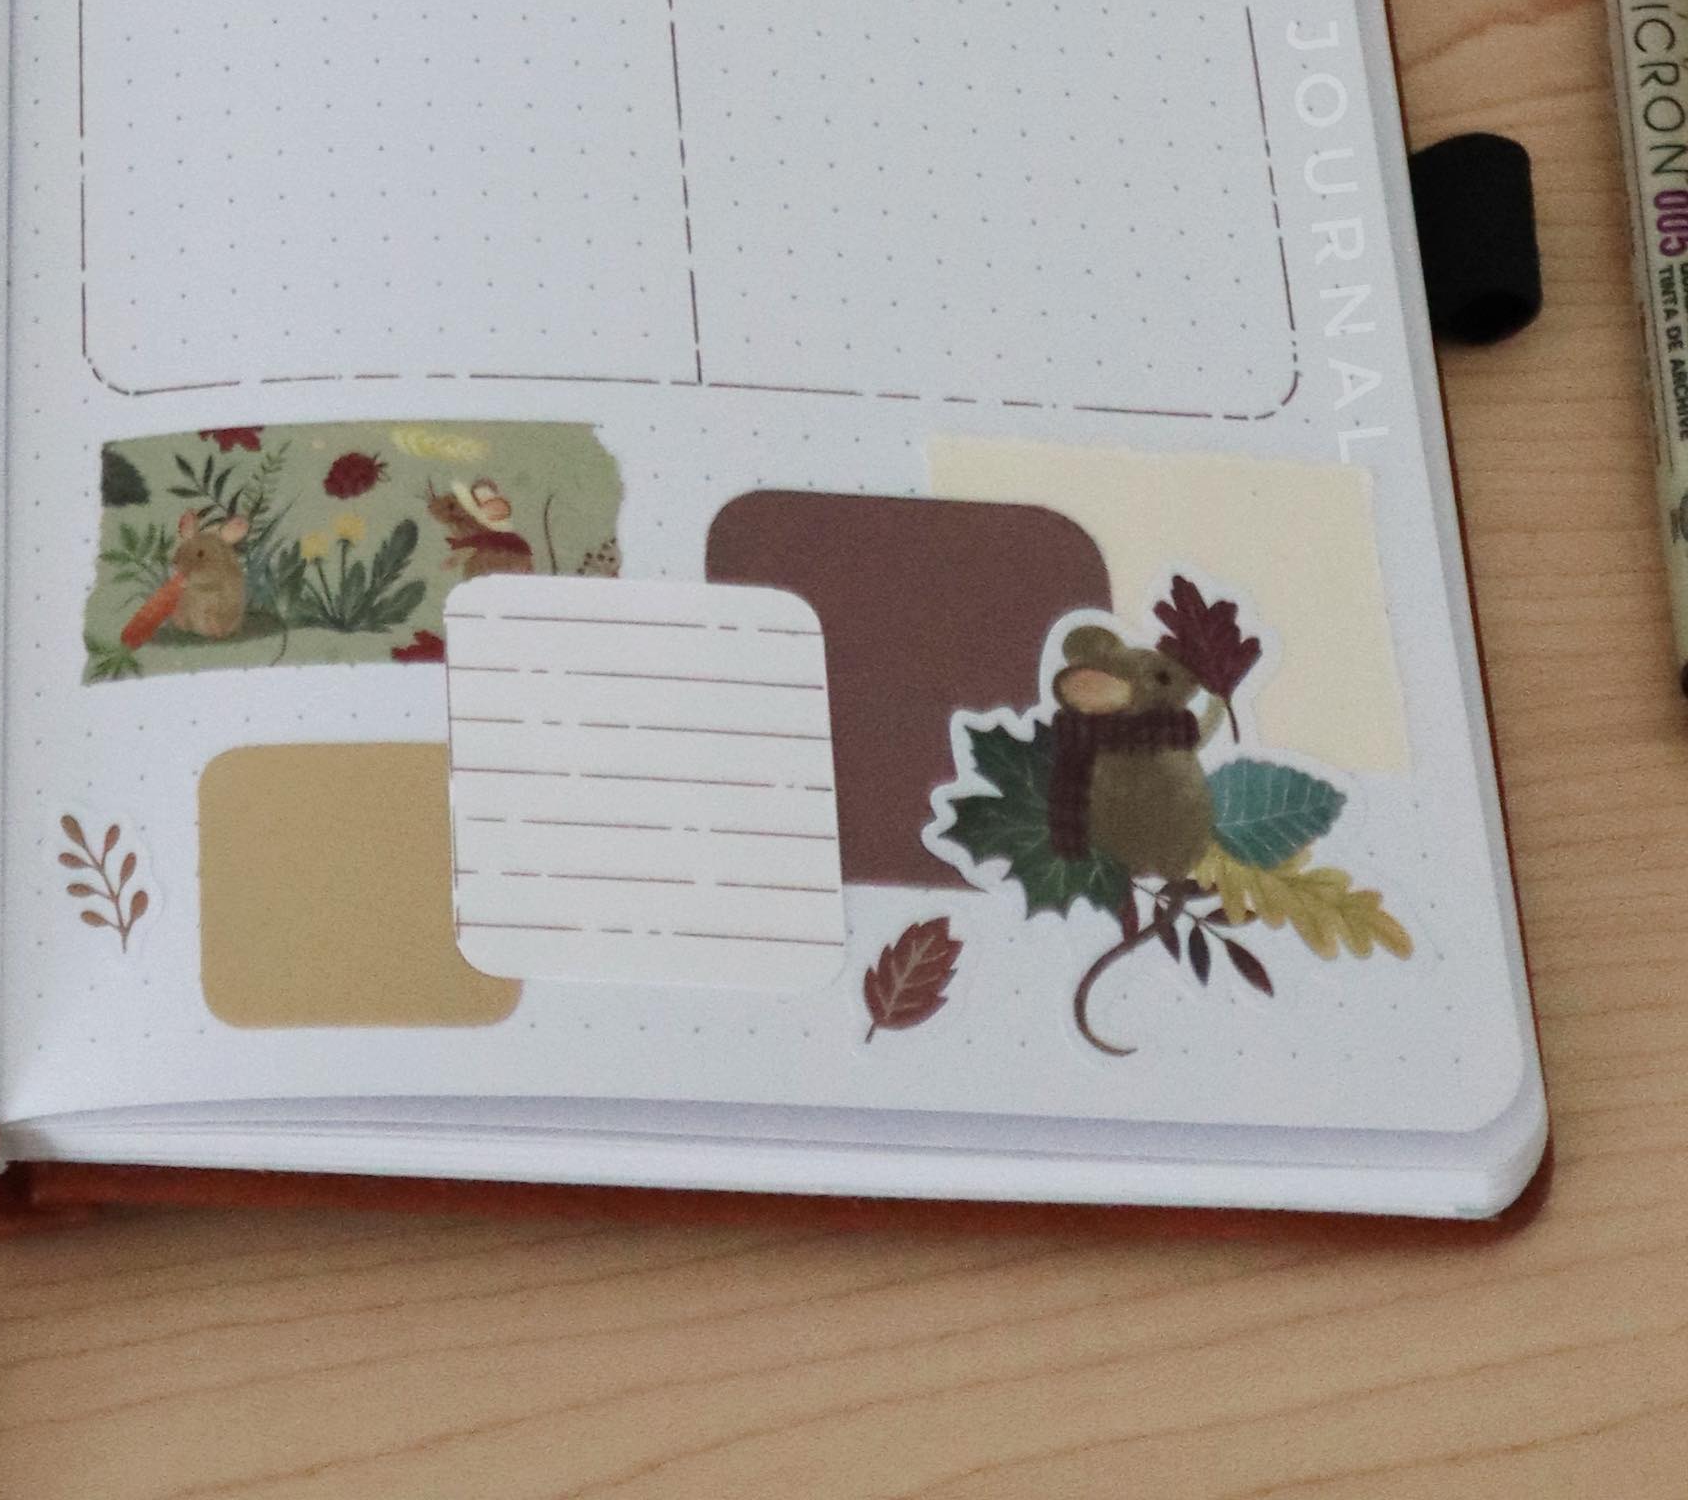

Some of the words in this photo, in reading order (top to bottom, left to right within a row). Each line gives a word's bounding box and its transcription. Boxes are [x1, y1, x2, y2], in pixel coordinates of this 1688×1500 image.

[1658, 264, 1680, 323] TINTA
[1666, 325, 1683, 353] DE
[1669, 358, 1688, 442] ARCHIVE
